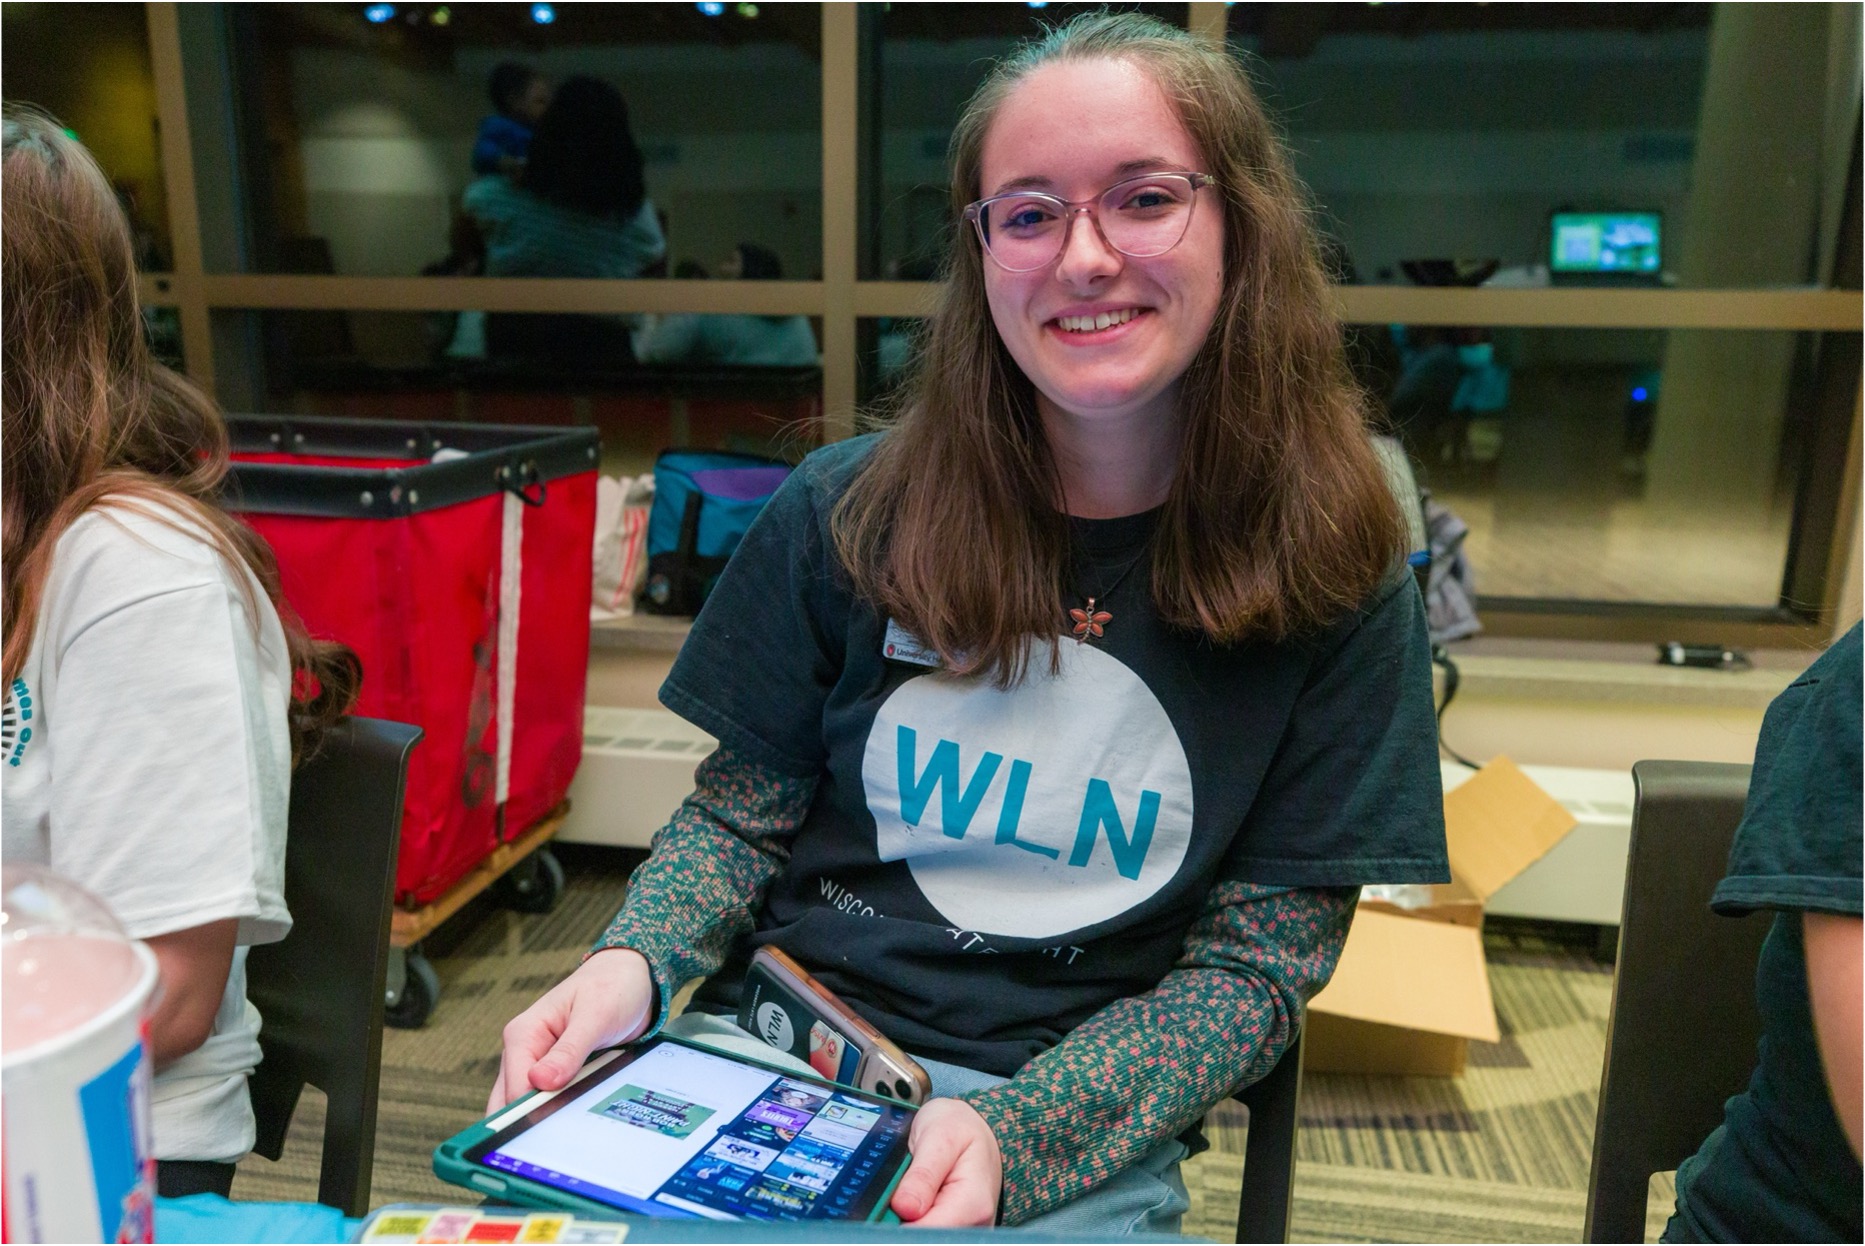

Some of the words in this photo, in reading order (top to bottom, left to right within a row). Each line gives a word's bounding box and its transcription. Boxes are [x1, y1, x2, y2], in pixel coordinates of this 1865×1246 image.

[12, 677, 32, 721] mes
[897, 725, 1162, 881] WLN
[820, 876, 884, 918] WISCO
[767, 1009, 784, 1046] WLN
